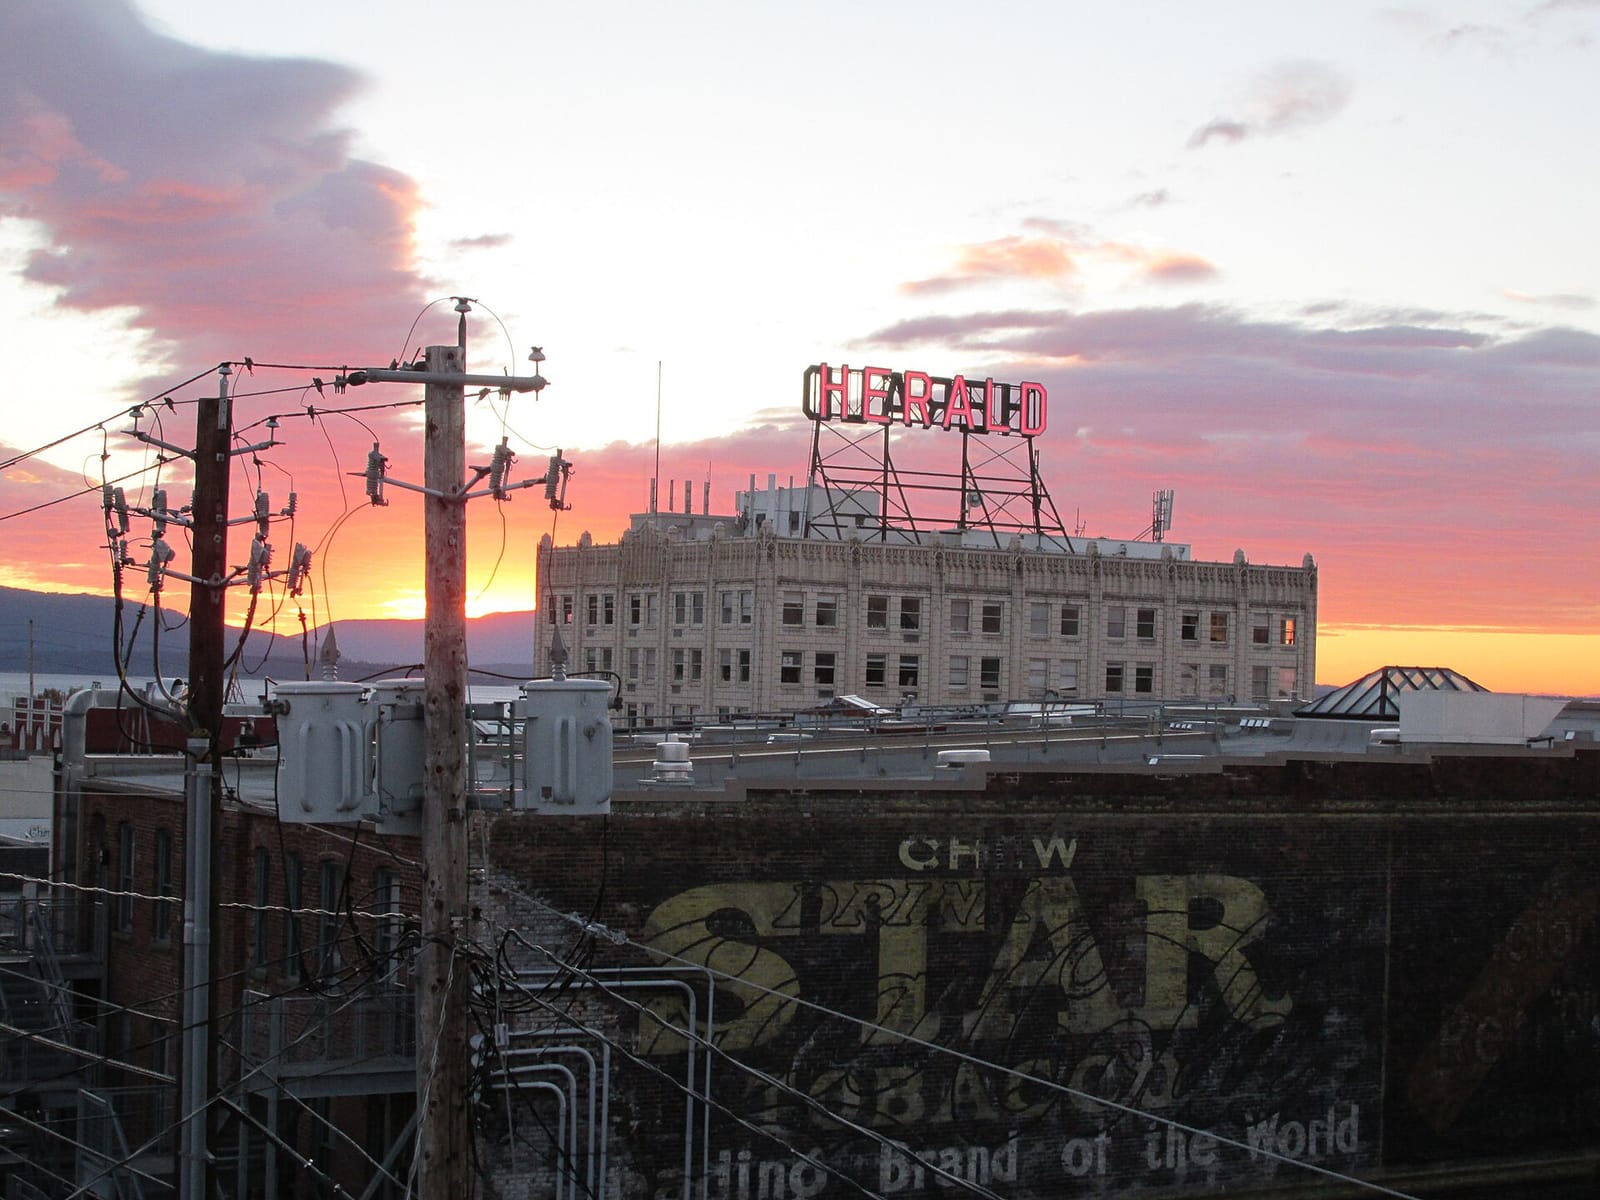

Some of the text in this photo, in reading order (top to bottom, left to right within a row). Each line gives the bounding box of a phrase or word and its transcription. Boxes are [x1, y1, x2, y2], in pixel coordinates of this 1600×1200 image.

[819, 362, 1047, 436] HERALD
[898, 832, 1077, 871] CHW
[638, 873, 1293, 1056] STAR
[1061, 1127, 1112, 1176] of
[1145, 1121, 1217, 1170] the
